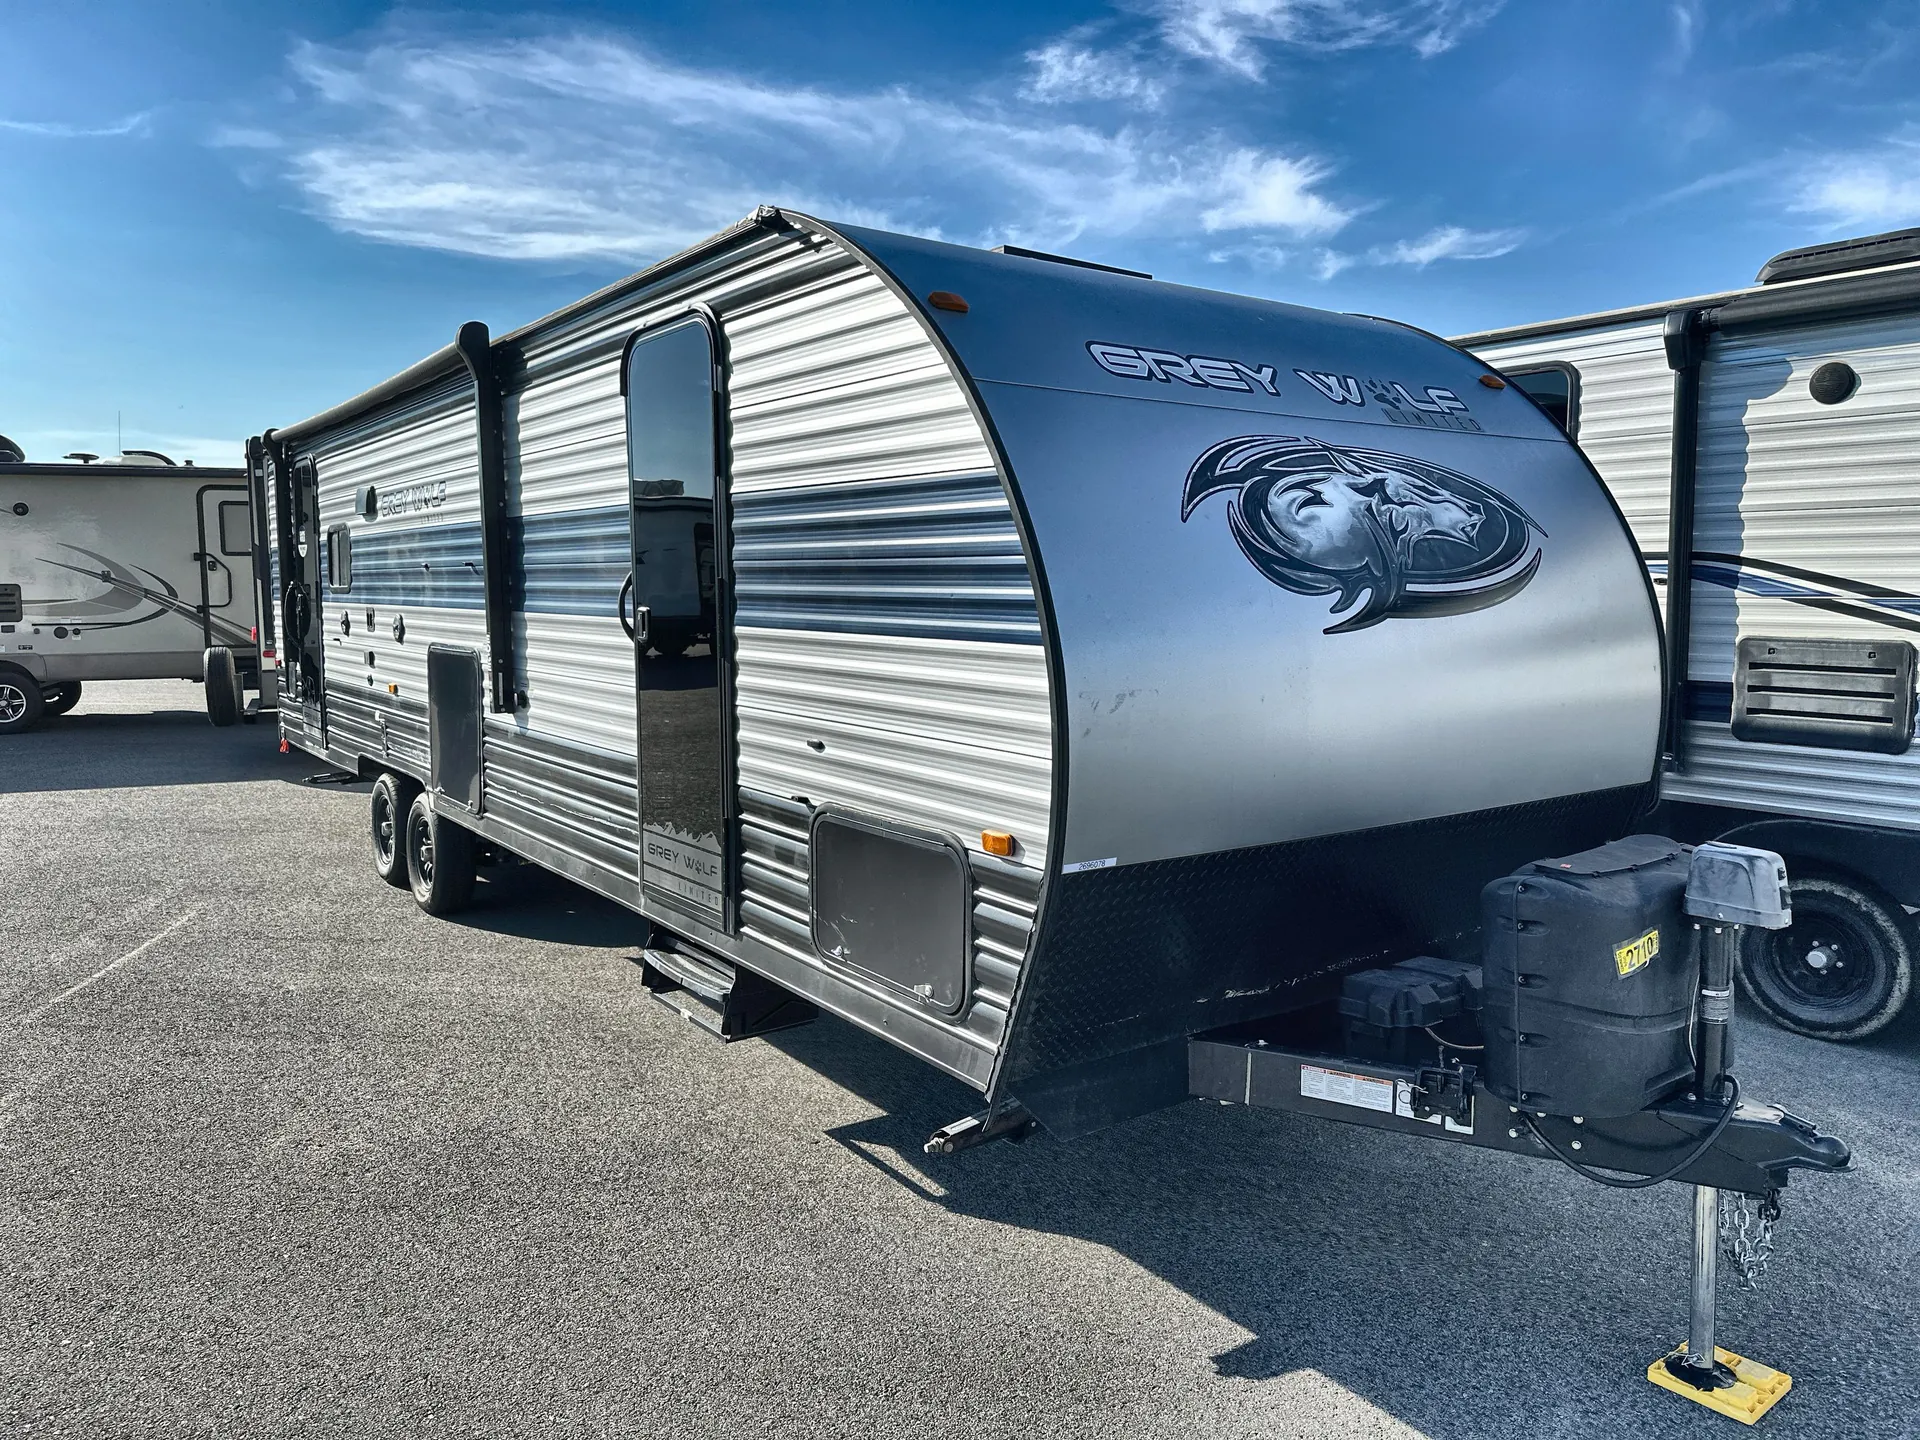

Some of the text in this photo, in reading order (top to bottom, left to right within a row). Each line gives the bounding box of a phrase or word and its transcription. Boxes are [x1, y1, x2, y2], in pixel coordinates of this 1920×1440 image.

[1085, 340, 1281, 397] GREY
[1382, 408, 1482, 431] LIMITED
[648, 843, 679, 863] GREY
[678, 882, 719, 906] LIMITED
[1626, 936, 1654, 969] 2710
